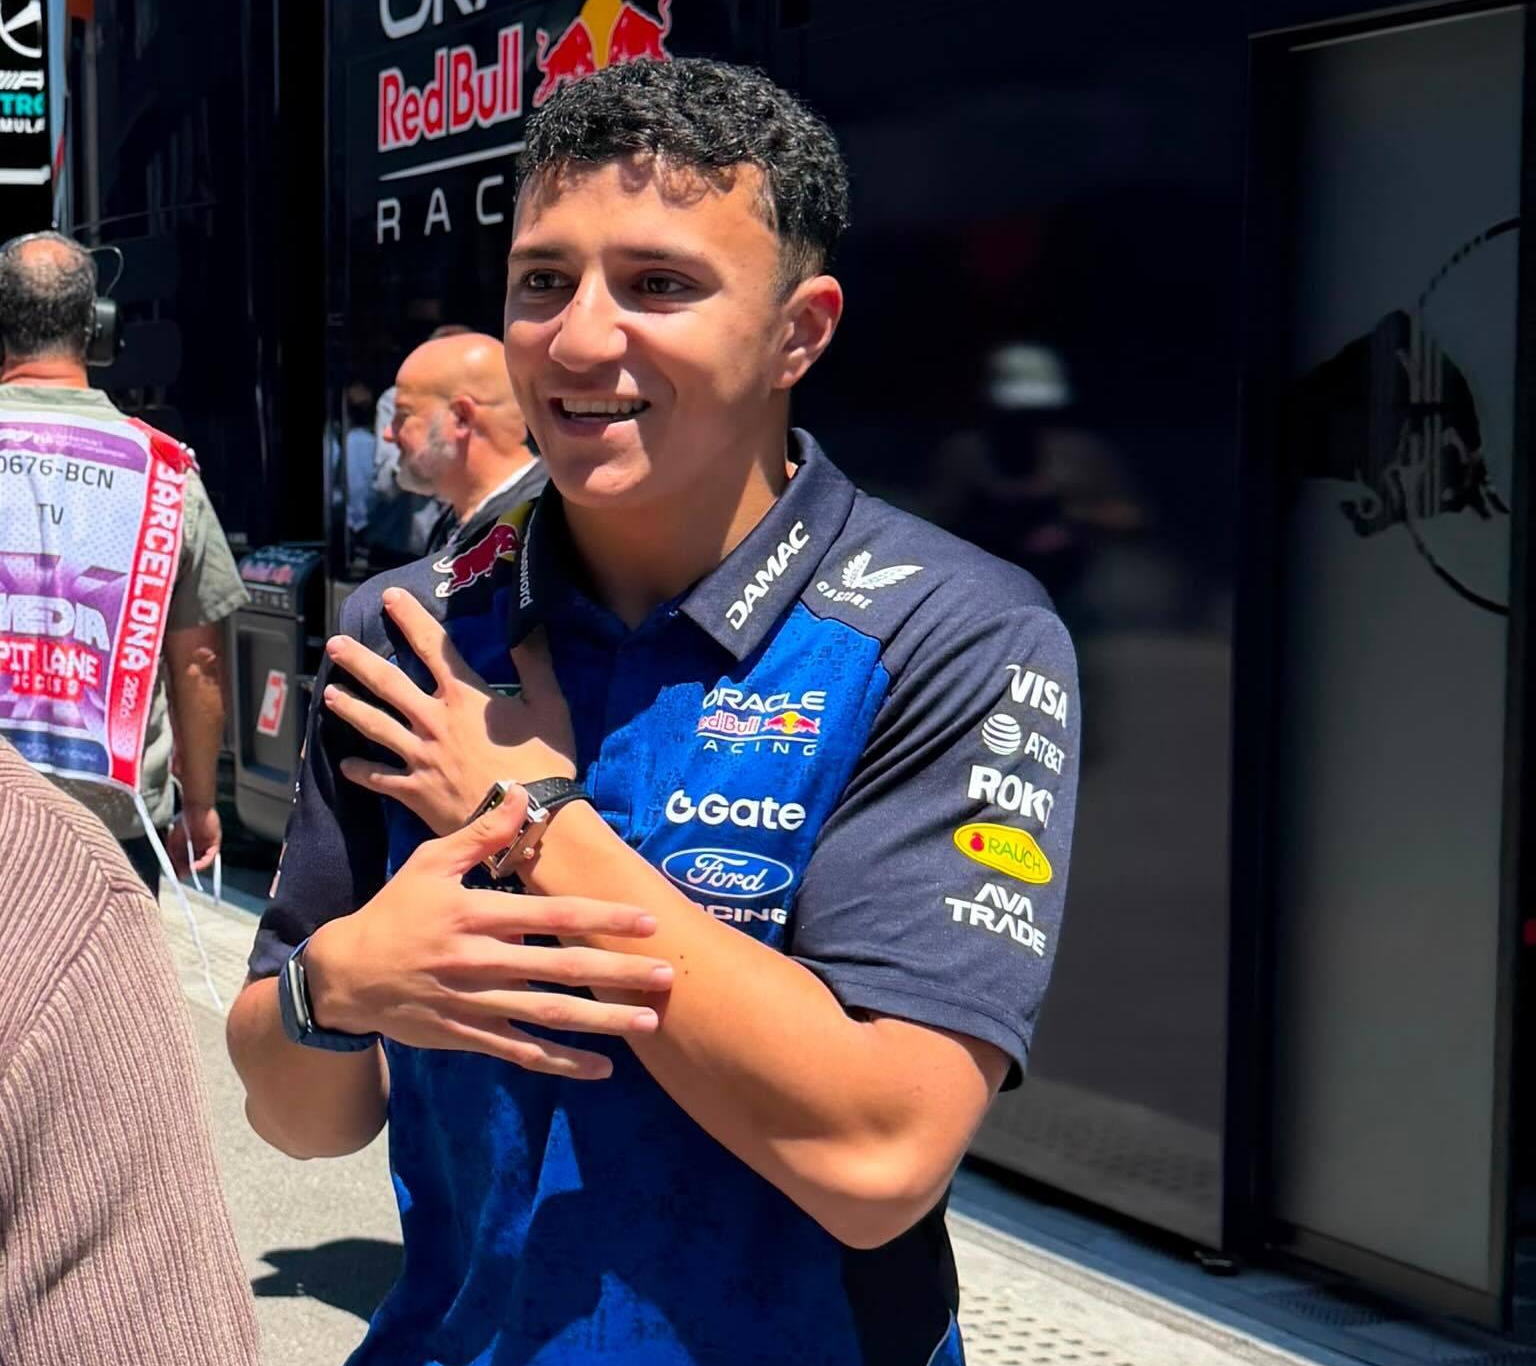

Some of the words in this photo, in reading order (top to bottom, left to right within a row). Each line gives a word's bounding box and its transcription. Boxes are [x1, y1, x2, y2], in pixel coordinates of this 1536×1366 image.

[377, 175, 505, 244] RAC
[37, 503, 64, 525] TV
[725, 521, 810, 630] DAMAC
[42, 644, 100, 685] LANE
[703, 688, 827, 713] ORACLE
[1005, 663, 1068, 729] VISA
[703, 739, 818, 756] ACING
[1024, 731, 1065, 775] AT&T
[686, 853, 769, 892] Ford
[988, 837, 1043, 875] RAUCH
[704, 904, 788, 925] CING
[974, 883, 1034, 923] AVA
[945, 897, 1047, 957] TRADE
